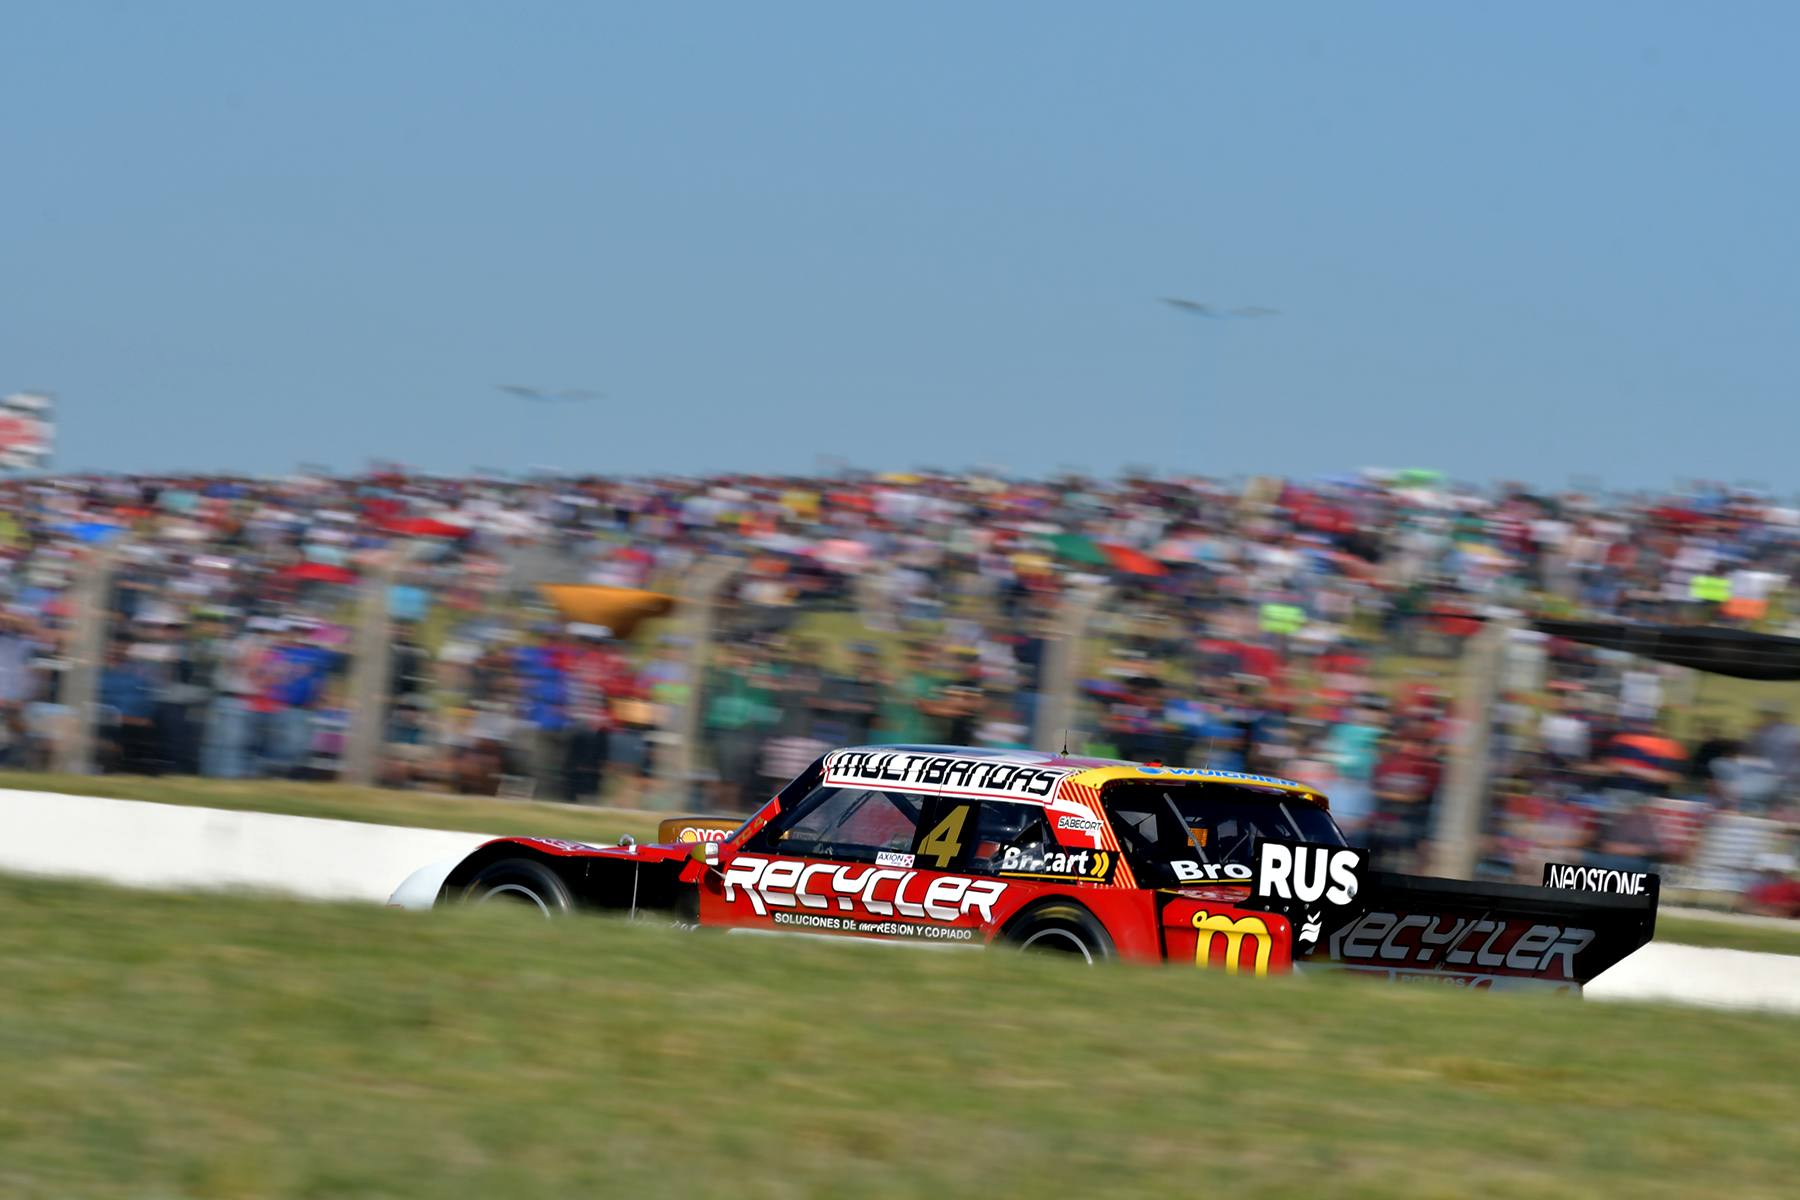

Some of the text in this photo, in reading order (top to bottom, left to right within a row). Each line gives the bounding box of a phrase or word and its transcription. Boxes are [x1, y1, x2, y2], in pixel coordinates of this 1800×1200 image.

[832, 752, 1063, 796] MULTIBANDAS
[917, 805, 970, 868] 4
[1058, 818, 1102, 831] SABECORT
[878, 853, 904, 861] AXION
[1259, 842, 1360, 905] RUS
[775, 912, 972, 940] SOLUCIONES DE IMPRESION Y COPIADO
